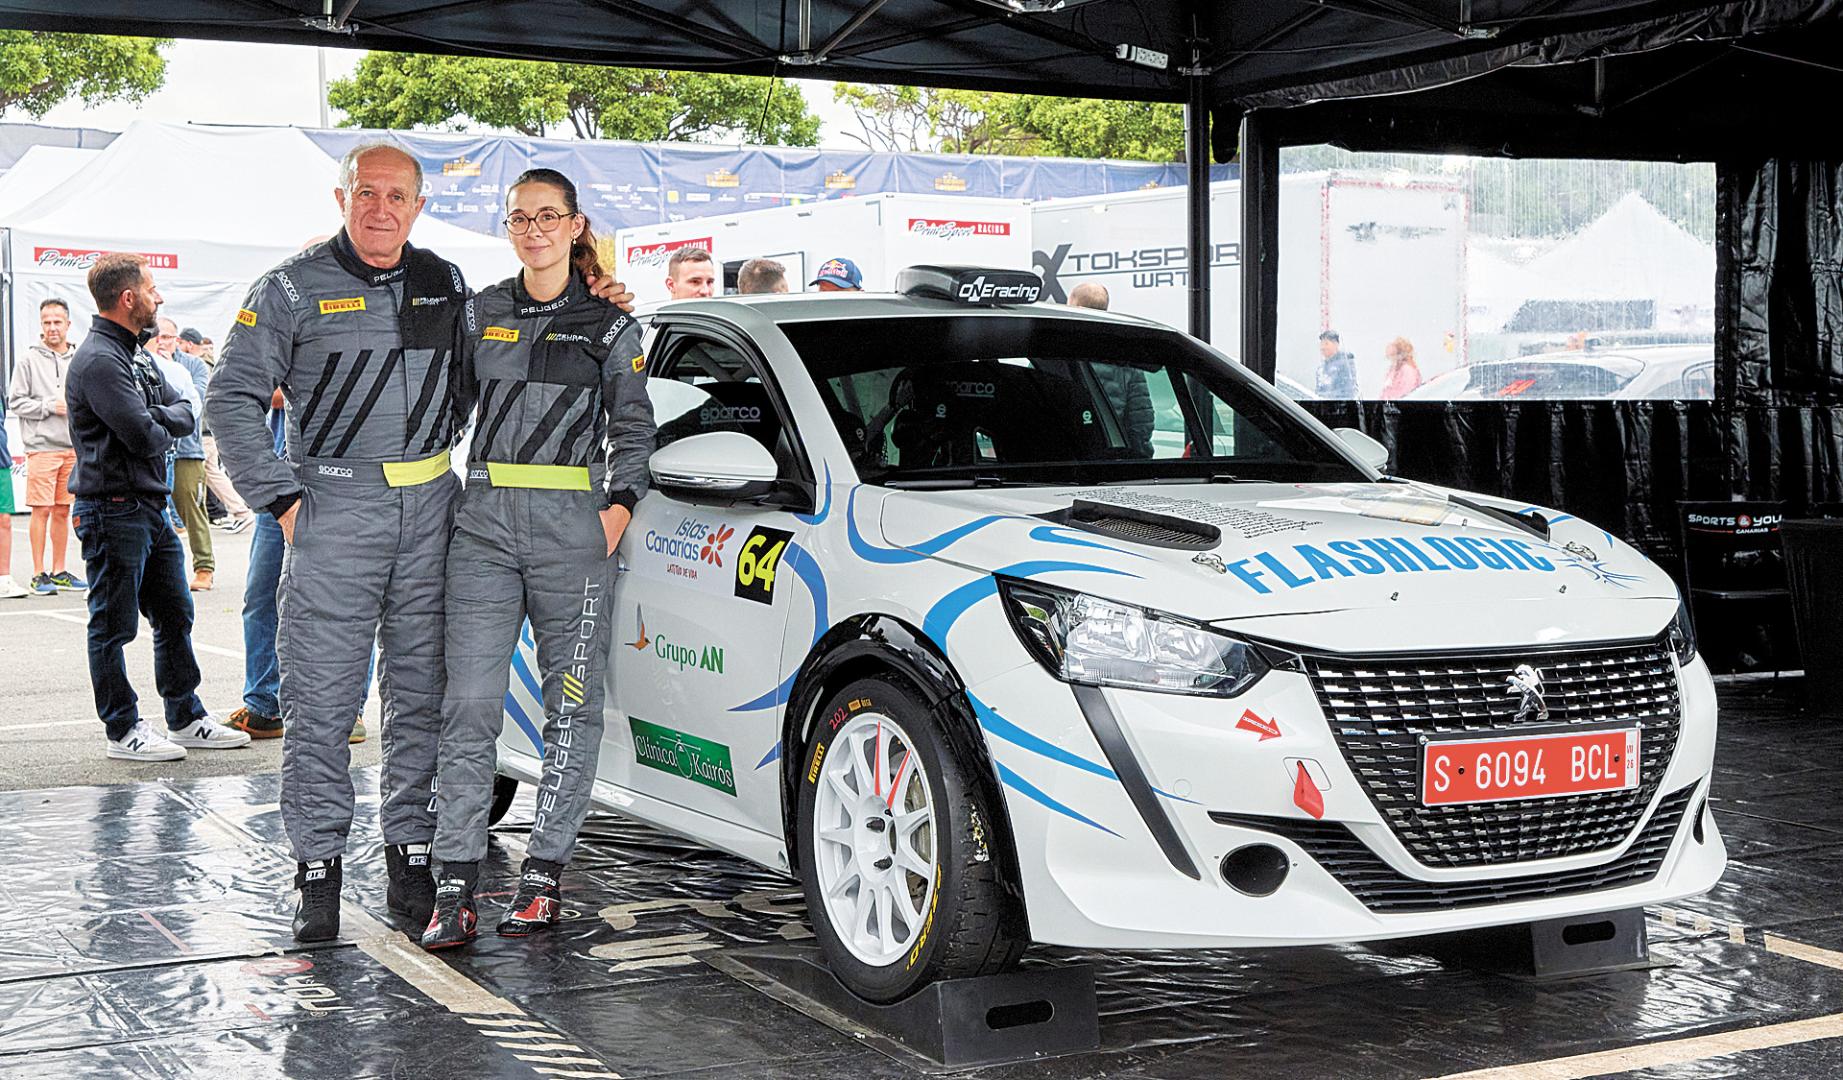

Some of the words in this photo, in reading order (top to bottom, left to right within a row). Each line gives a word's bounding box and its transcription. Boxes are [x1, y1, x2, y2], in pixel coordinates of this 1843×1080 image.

[977, 223, 1005, 234] RACING
[38, 250, 99, 270] PrintS
[276, 271, 300, 303] sparco
[1132, 271, 1188, 288] WRT
[322, 299, 363, 311] PIRELLI
[521, 296, 570, 315] PEUGEOT
[602, 315, 629, 346] sparco
[700, 405, 761, 424] sparco
[317, 464, 353, 477] sparco
[675, 517, 709, 540] Islas
[1688, 514, 1736, 526] SPORTS
[646, 530, 699, 562] Canarias
[738, 534, 785, 592] 64
[1226, 536, 1556, 595] FLASHLOGIC
[655, 634, 697, 671] Grupo
[700, 645, 724, 674] AN
[535, 697, 577, 833] PEUGEOT
[571, 577, 600, 682] SPORT
[829, 707, 848, 730] 202
[635, 735, 677, 767] Clínica
[691, 752, 733, 788] Kairós
[808, 742, 825, 784] PIRELLI
[1434, 755, 1450, 792] S
[1475, 749, 1546, 789] 6094
[1571, 743, 1618, 782] BCL
